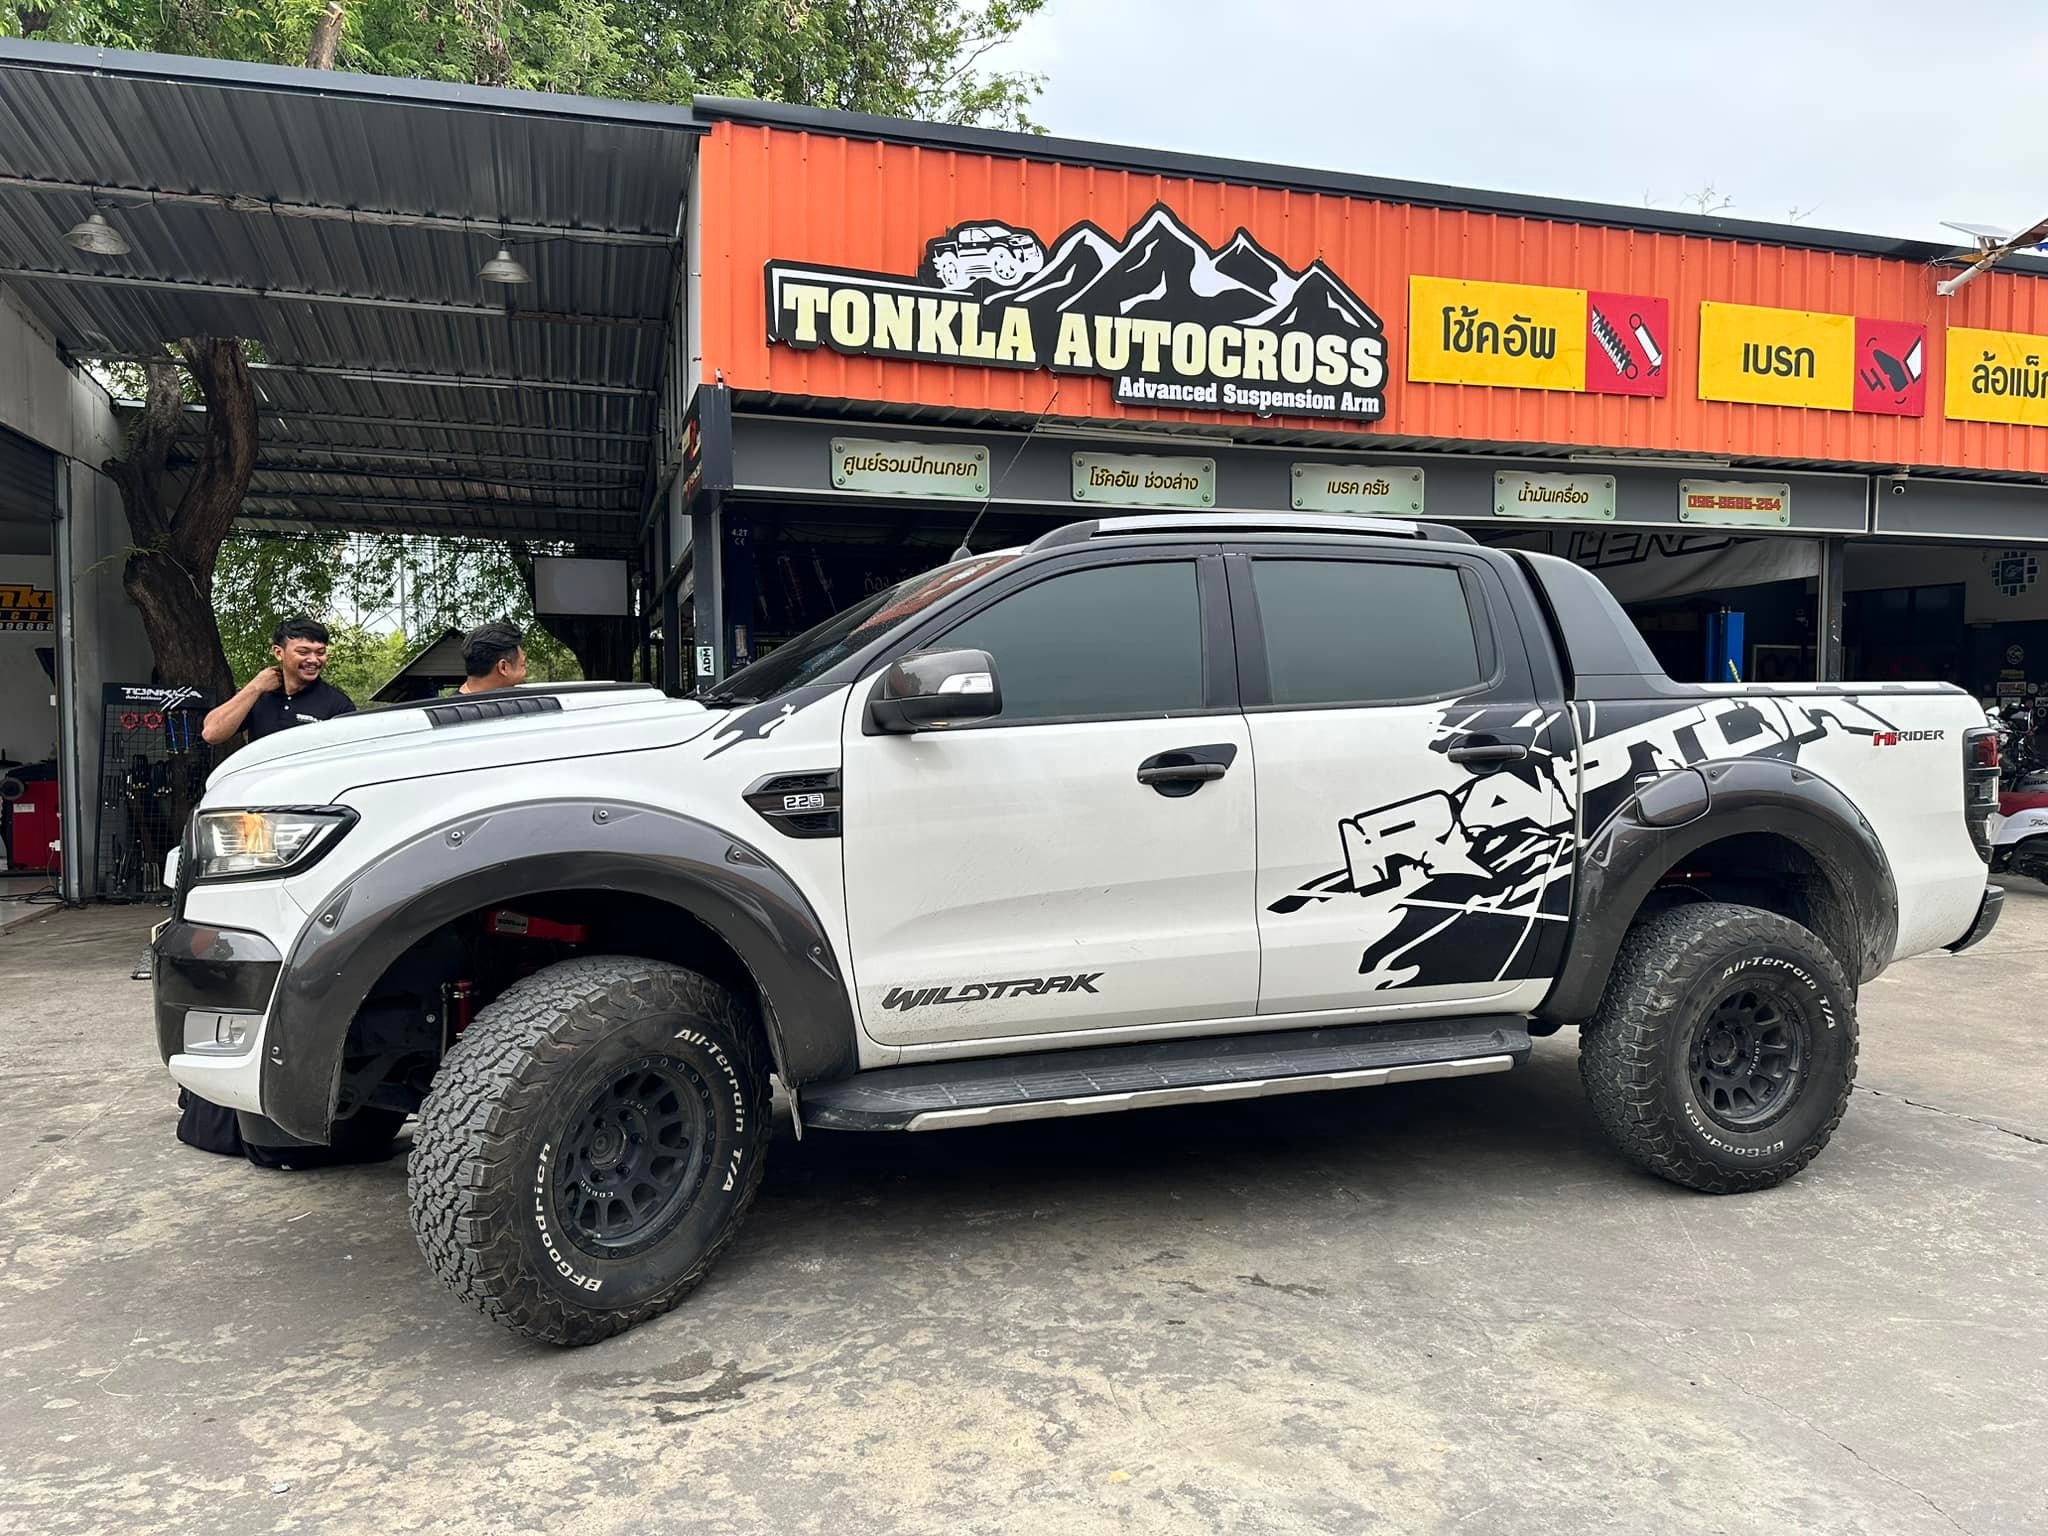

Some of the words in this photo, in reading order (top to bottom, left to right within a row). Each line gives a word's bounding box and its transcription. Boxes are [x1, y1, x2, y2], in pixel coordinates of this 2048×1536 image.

[783, 283, 1036, 363] TONKLA
[1054, 313, 1385, 388] AUTOCROSS
[1442, 305, 1556, 359] โช้คอัพ
[1743, 343, 1814, 378] เบรก
[1118, 376, 1217, 403] Advanced
[1223, 385, 1335, 411] Suspension
[1340, 392, 1380, 413] Arm
[1144, 470, 1199, 490] ช่วงล่าง
[1327, 479, 1359, 496] เบรค
[1518, 481, 1589, 504] น้ำมันเครื่อง
[703, 648, 711, 673] ADM
[881, 972, 1104, 1011] WILDTRAK
[1722, 956, 1817, 990] All-Terrain
[1819, 995, 1837, 1029] T/A
[674, 1028, 744, 1132] All-Terrain
[722, 1148, 743, 1192] T/A
[1684, 1102, 1785, 1158] BFGoodrich
[534, 1143, 603, 1292] BFGoodrich
